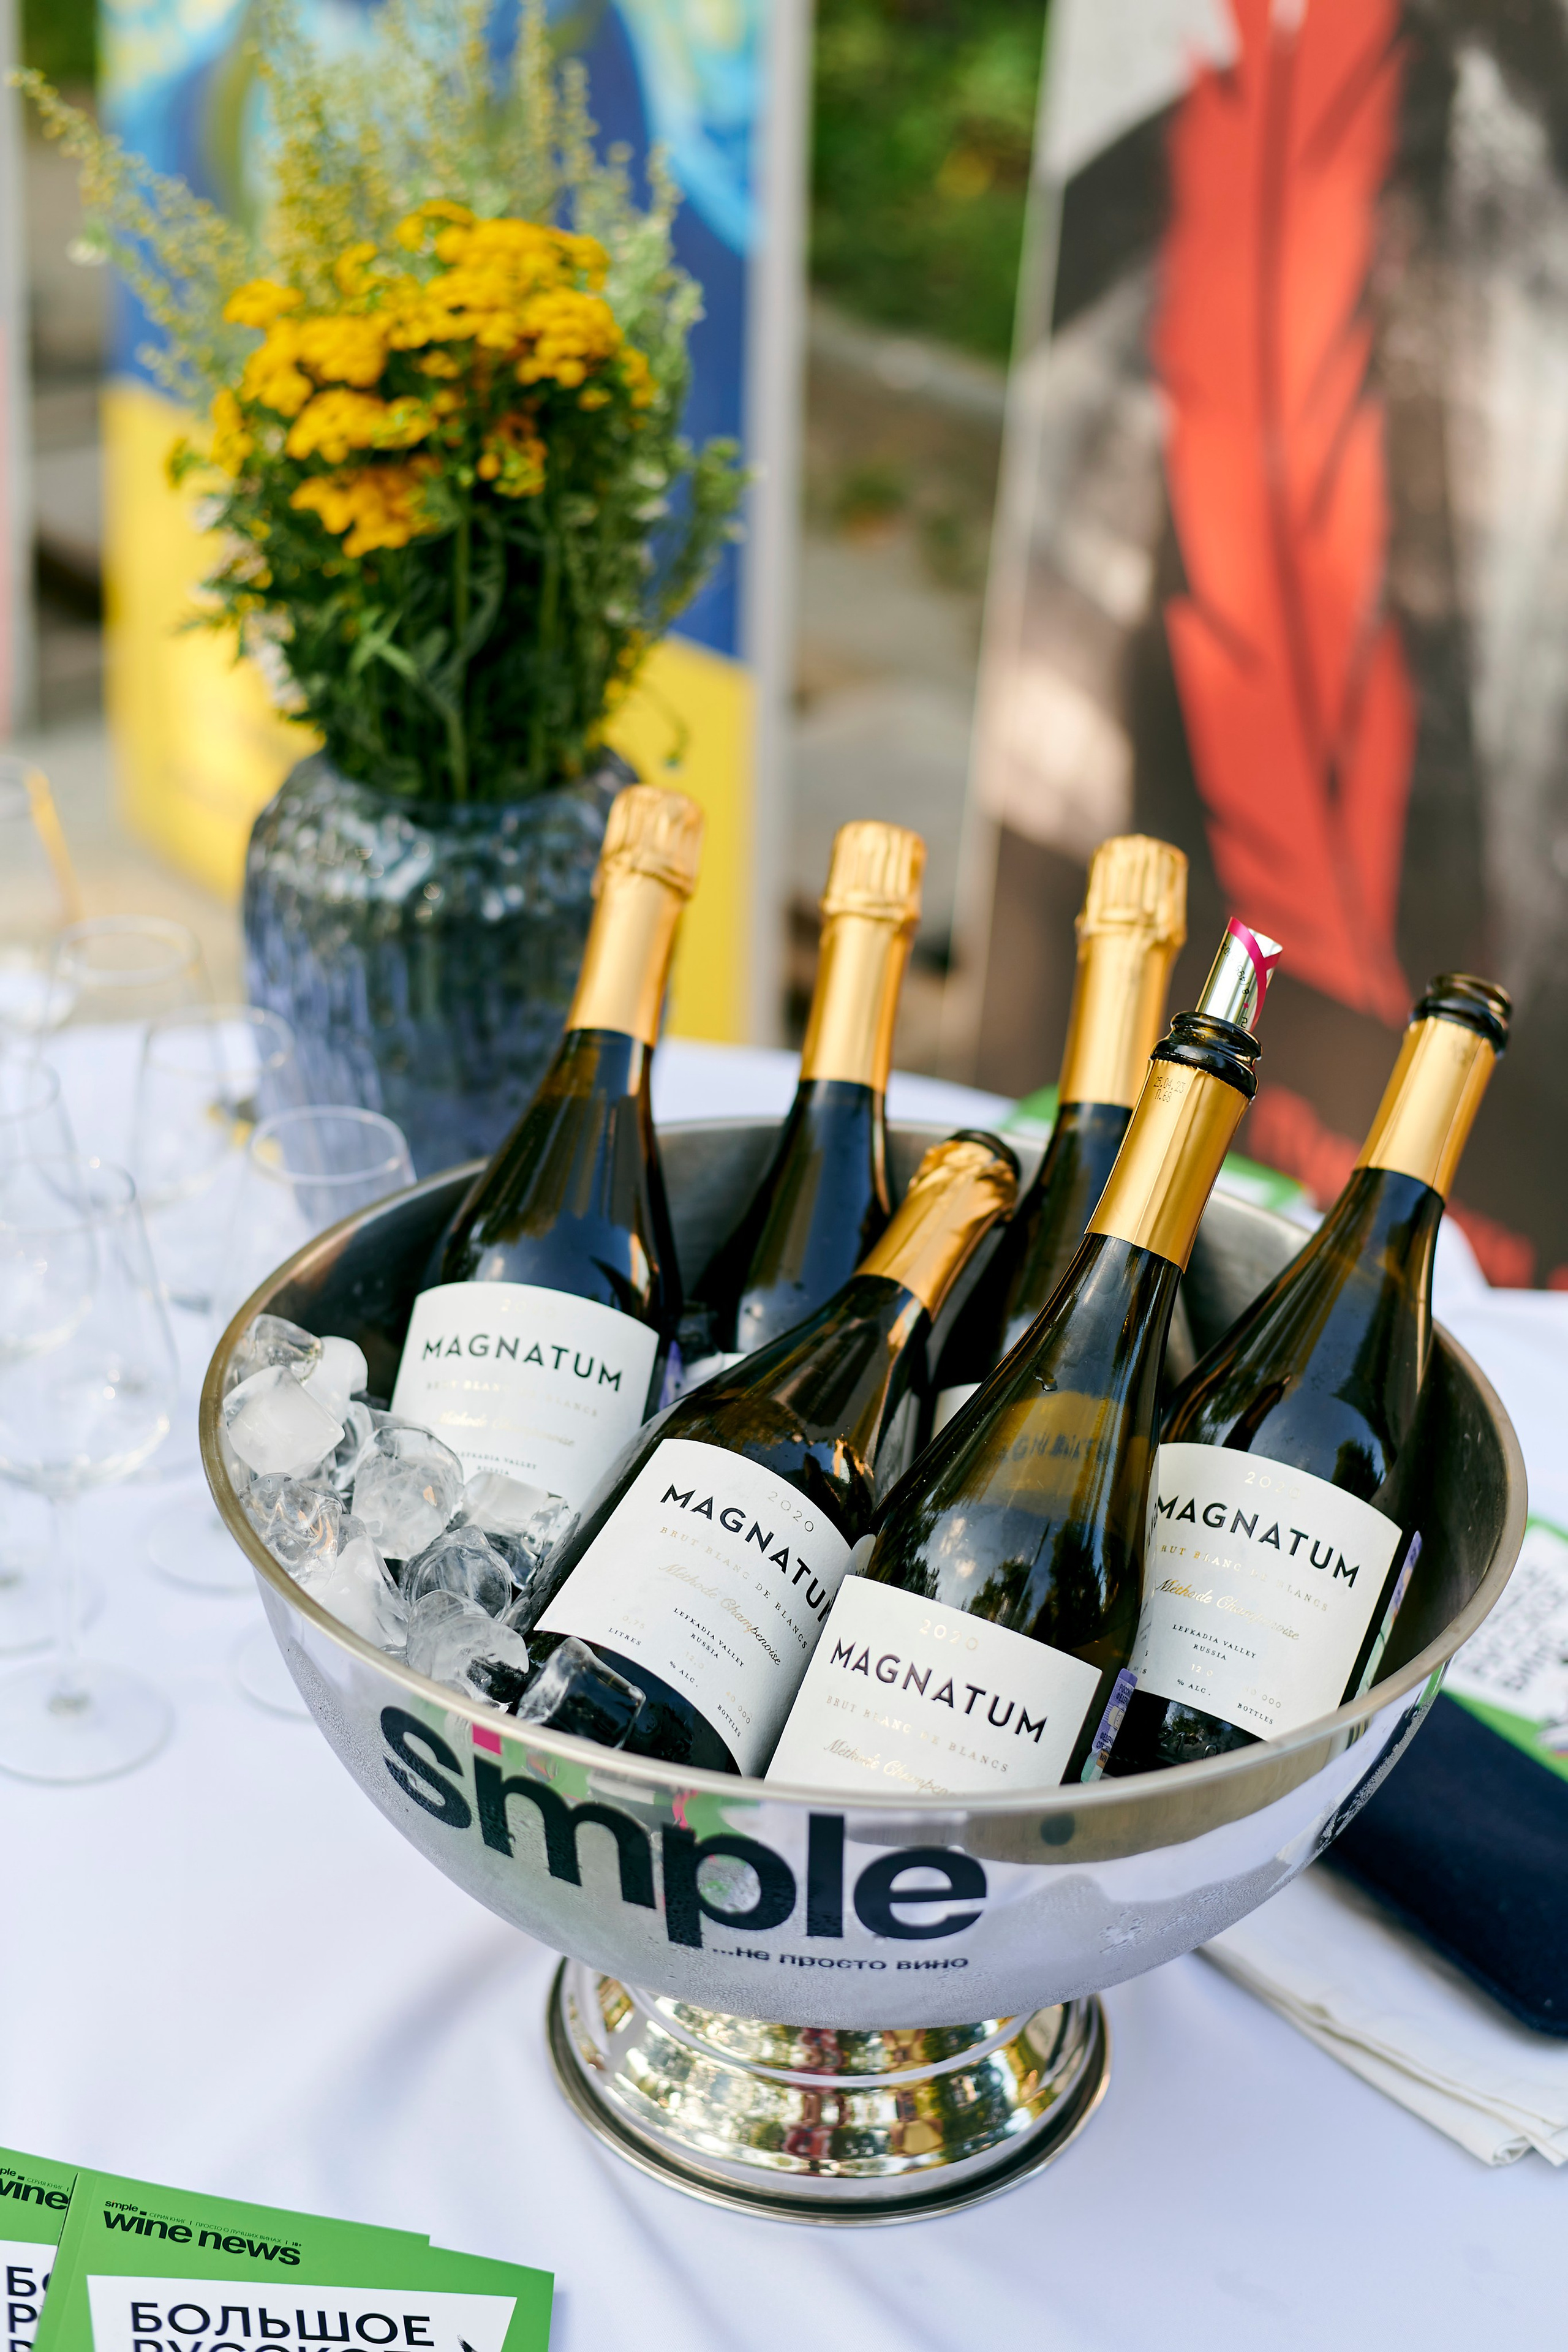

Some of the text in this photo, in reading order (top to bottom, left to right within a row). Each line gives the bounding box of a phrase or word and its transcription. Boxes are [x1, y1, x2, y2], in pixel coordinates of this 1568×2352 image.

[421, 1333, 623, 1393] MAGNATUM
[1245, 1471, 1300, 1500] 2020
[767, 1491, 815, 1532] 2020
[1158, 1494, 1360, 1588] MAGNATUM
[660, 1526, 807, 1649] BRUT BLANC DE BLANCS
[1193, 1550, 1242, 1572] BLANC
[1250, 1569, 1267, 1583] DE
[1278, 1579, 1329, 1613] BLANCS
[658, 1563, 782, 1665] Méthode Champenoise
[1155, 1578, 1300, 1641] Méthode Champenoise
[608, 1627, 642, 1646] LITRES
[674, 1607, 745, 1667] LEFKADIA VALLEY
[690, 1632, 720, 1659] RUSSIA
[919, 1618, 979, 1651] 2020
[1172, 1623, 1257, 1659] LEFKADIA VALLEY
[1193, 1643, 1227, 1660] RUSSIA
[829, 1637, 1048, 1744] MAGNATUM
[717, 1704, 741, 1738] BOTTLES
[826, 1695, 1009, 1772] BRUT BLANC DE BLANCS
[1237, 1703, 1275, 1725] BOTTLES
[380, 1706, 987, 1948] simple
[779, 1953, 887, 1970] просто
[896, 1957, 969, 1970] вино
[26, 2177, 47, 2186] СЕРИЯ
[105, 2200, 138, 2212] simple
[104, 2210, 301, 2266] wine news
[149, 2212, 169, 2220] СЕРИЯ
[195, 2222, 222, 2231] ПРОСТО
[230, 2228, 258, 2239] ЛУЧШИХ
[259, 2235, 282, 2244] ВИНАХ
[130, 2301, 435, 2346] БОЛЬШОЕ
